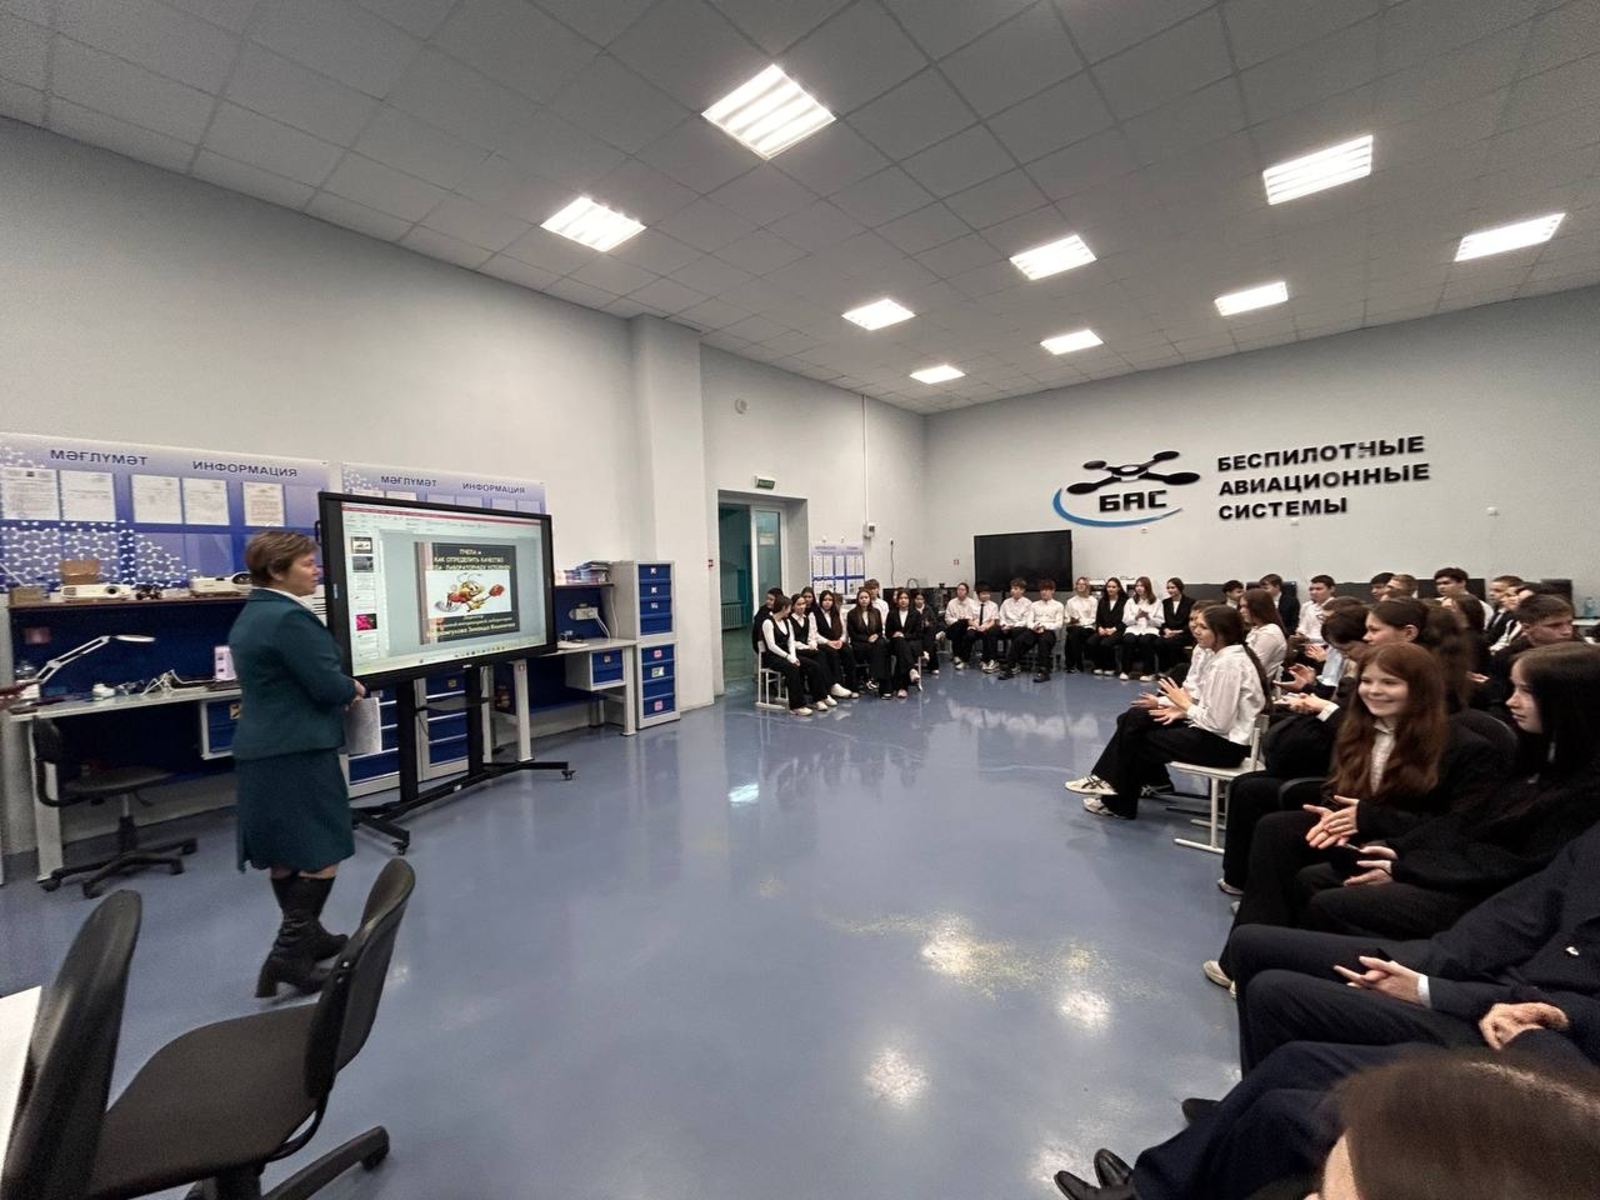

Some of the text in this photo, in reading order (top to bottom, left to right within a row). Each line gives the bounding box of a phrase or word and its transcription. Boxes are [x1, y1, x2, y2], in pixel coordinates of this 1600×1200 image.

[1217, 435, 1425, 472] БЕСПИЛОТНЫЕ
[192, 460, 298, 478] ИНФОРМАЦИЯ
[1218, 463, 1431, 497] АВИАЦИОННЫЕ
[462, 482, 526, 494] ИНФОРМАЦИЯ
[1099, 489, 1168, 512] БАС
[1218, 497, 1347, 520] СИСТЕМЫ
